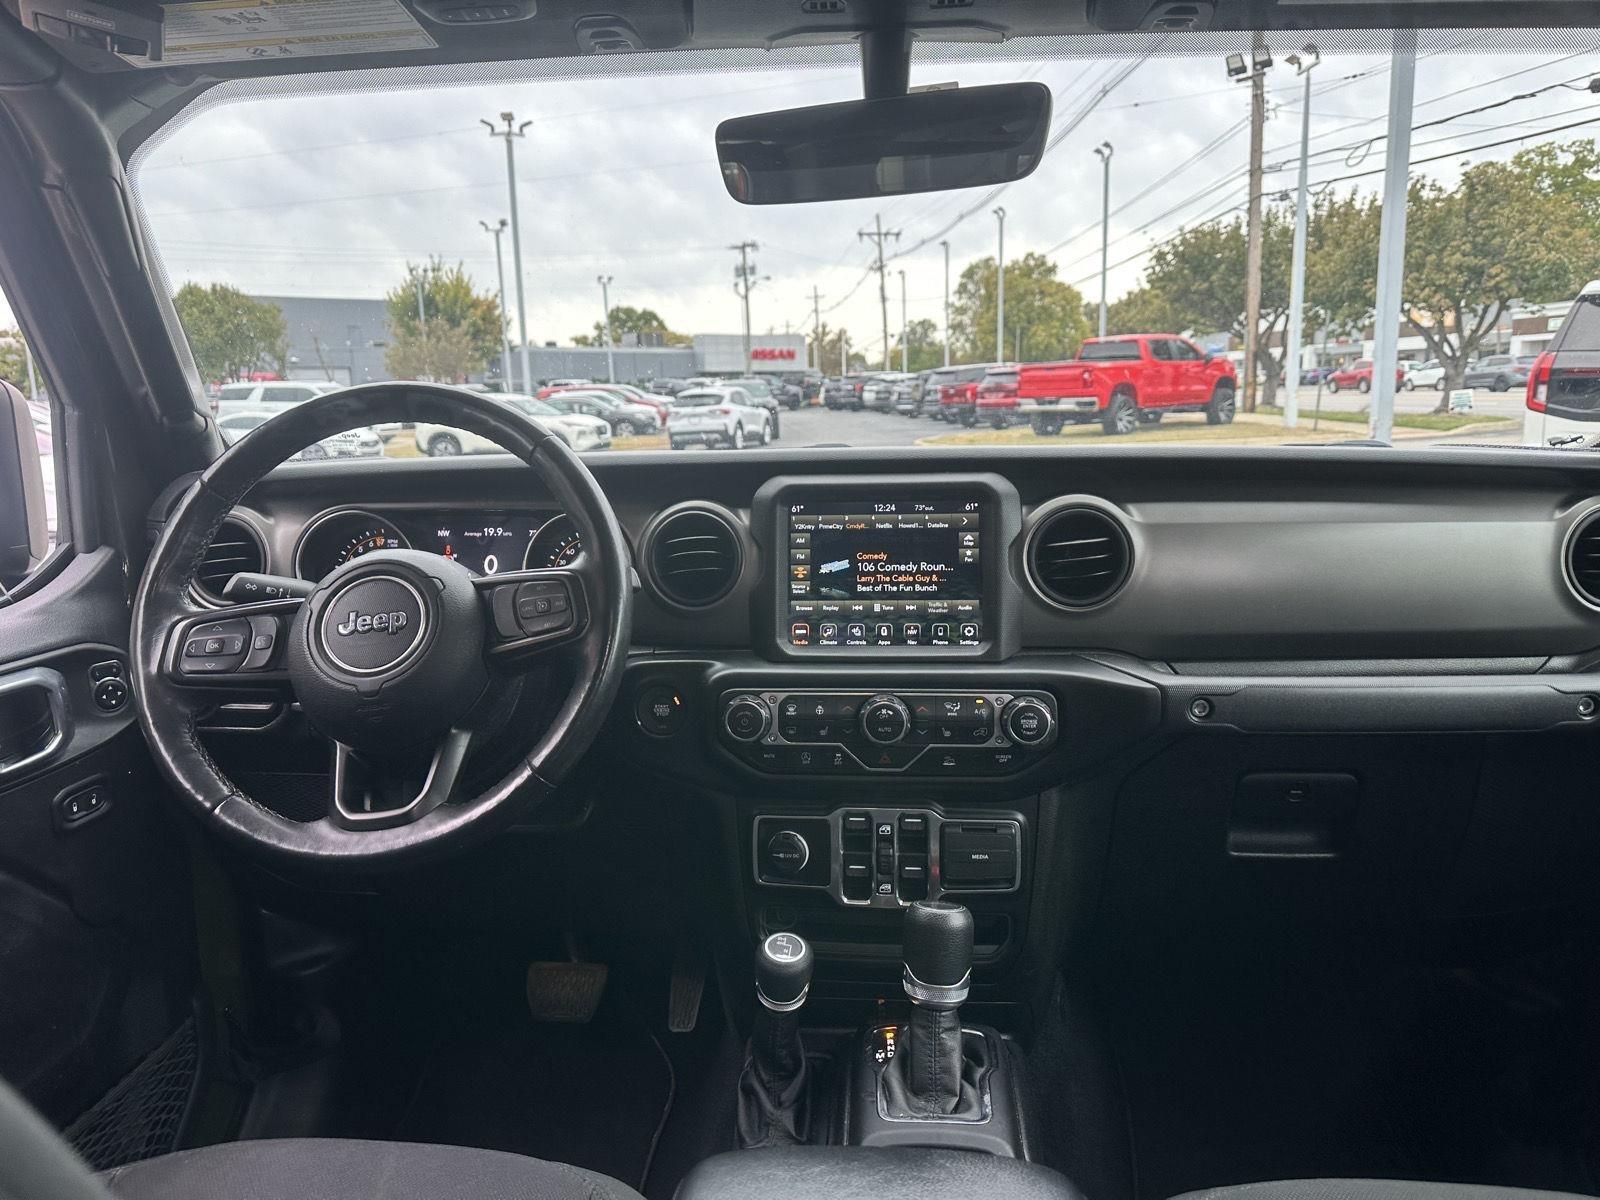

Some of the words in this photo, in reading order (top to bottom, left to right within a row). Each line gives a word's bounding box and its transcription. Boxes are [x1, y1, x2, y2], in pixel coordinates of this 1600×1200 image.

[791, 505, 804, 513] 61°
[874, 504, 896, 512] 12:24
[965, 503, 978, 511] 61°
[484, 528, 503, 537] 19.9
[856, 552, 888, 560] Comedy
[484, 554, 498, 575] 0
[857, 563, 875, 572] 106
[877, 562, 916, 574] Comedy
[856, 574, 874, 584] Larry
[914, 574, 930, 584] Guy
[874, 584, 883, 592] of
[337, 610, 408, 635] Jeep
